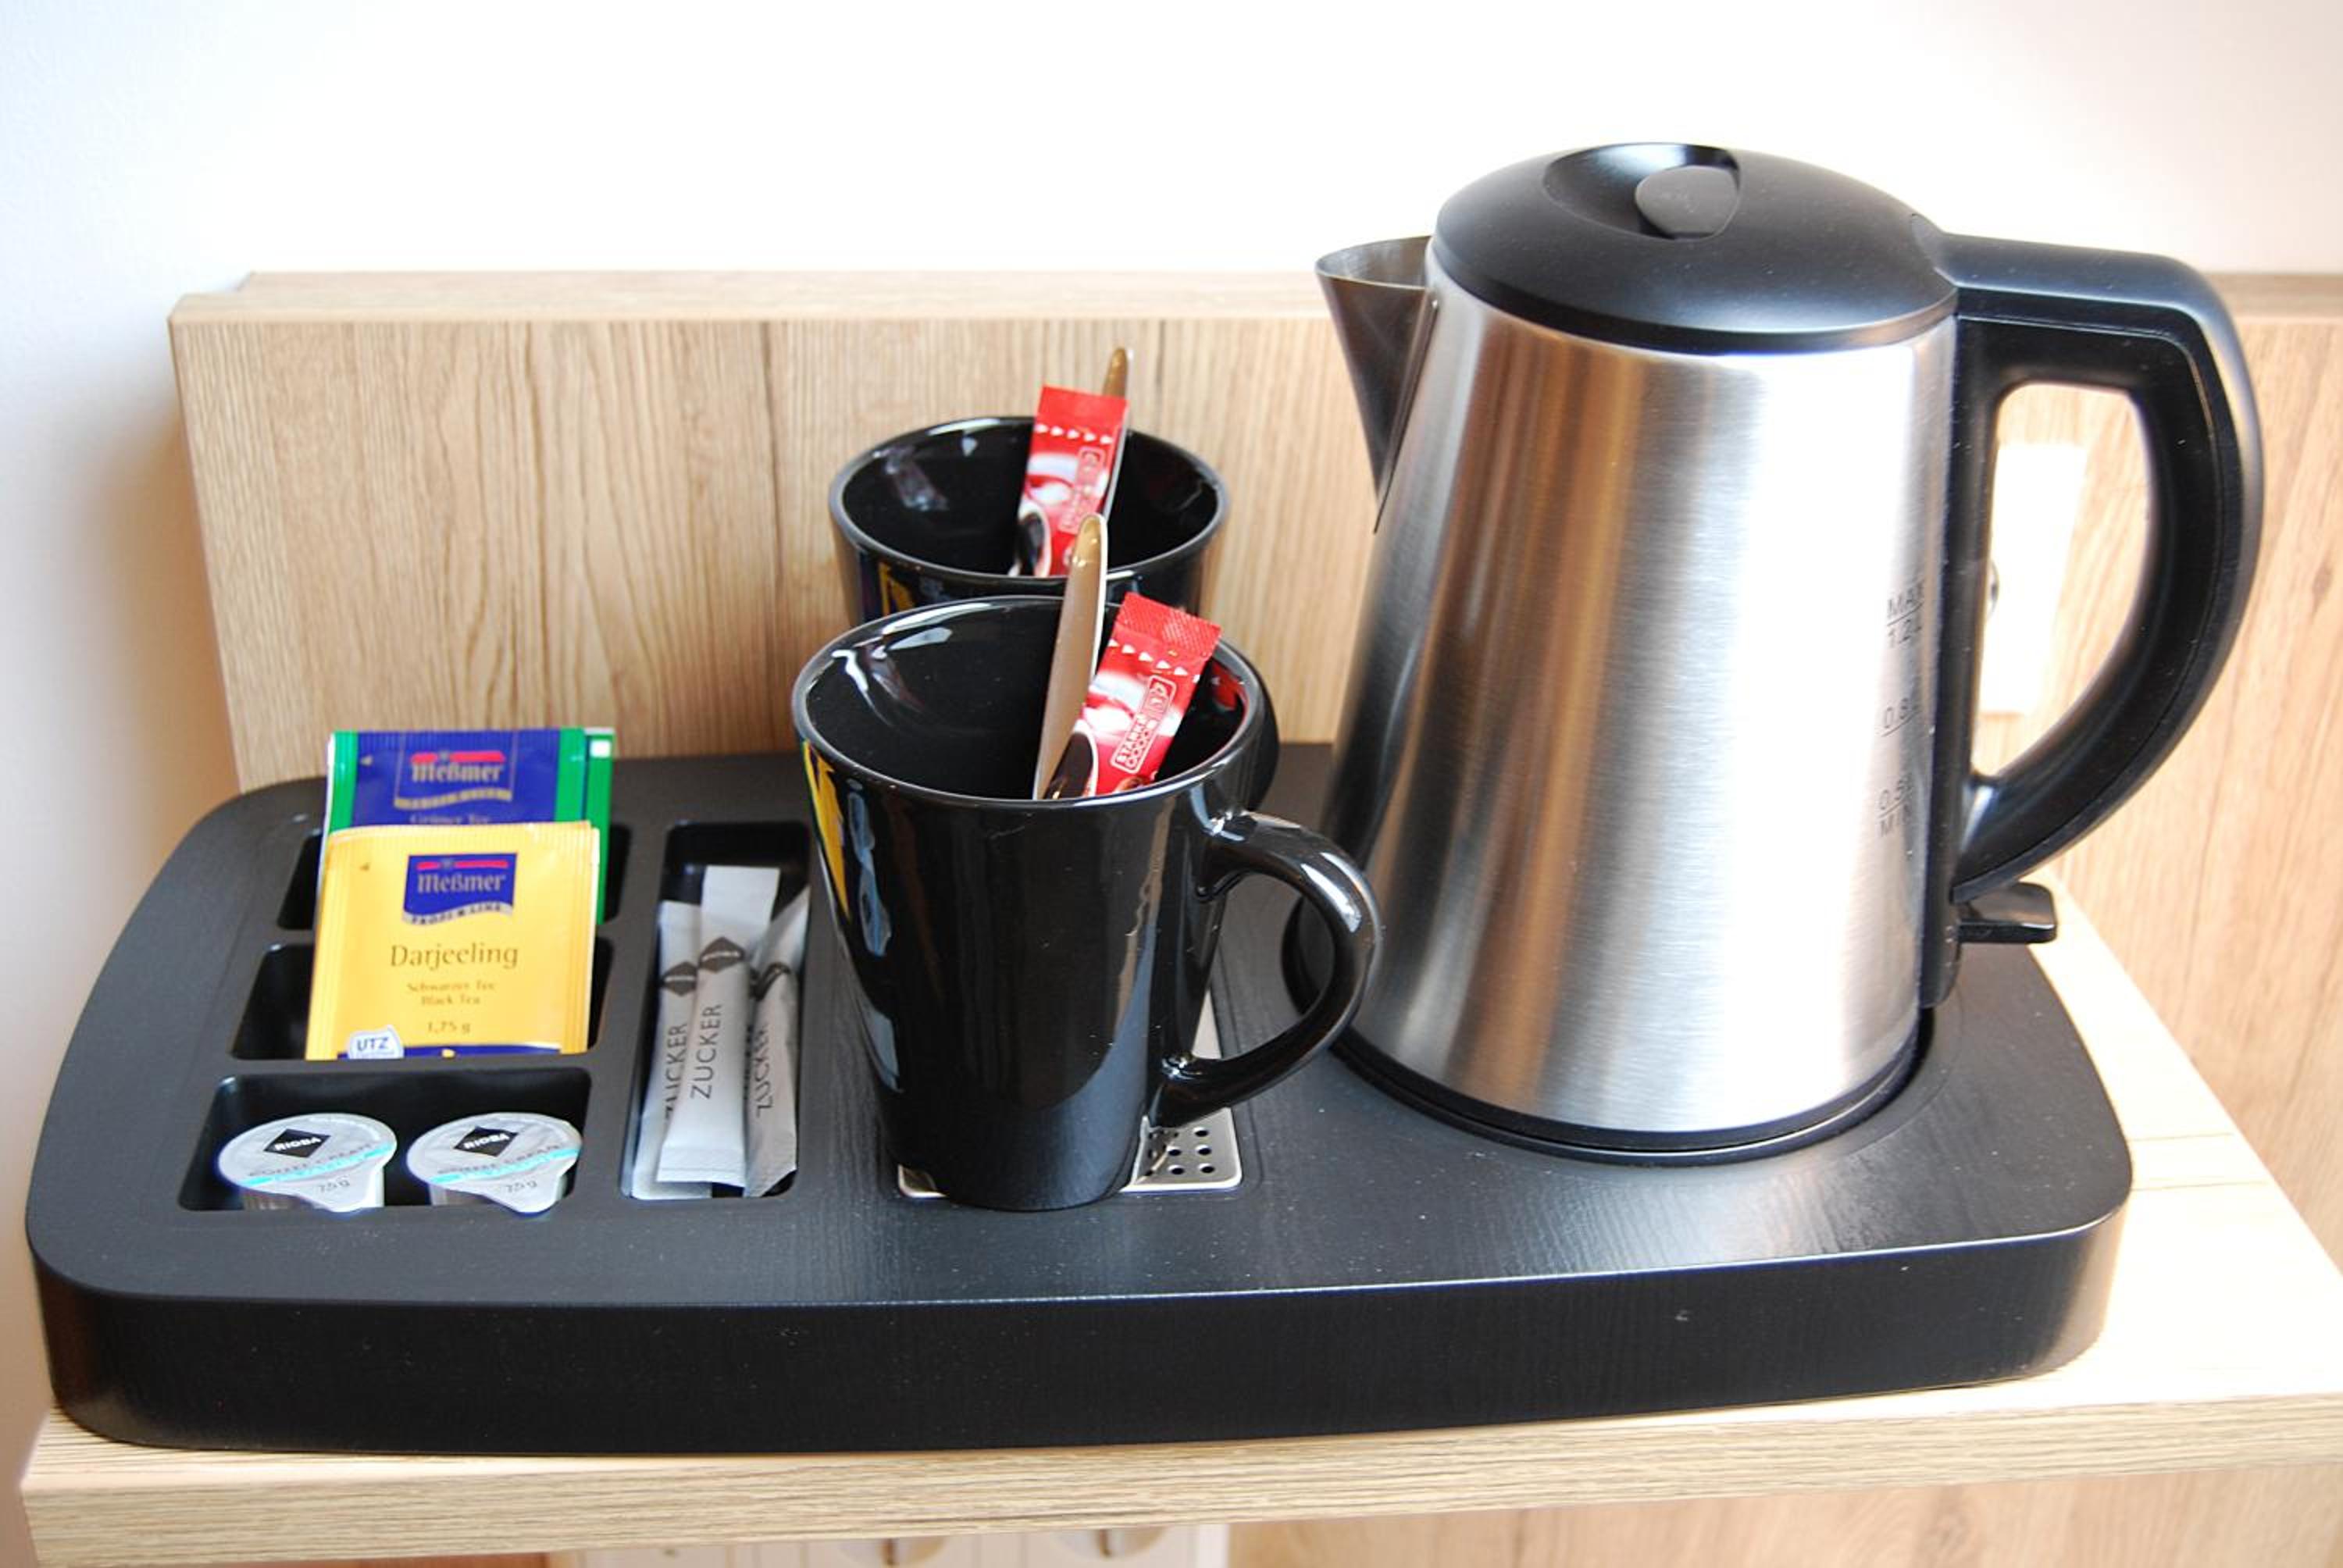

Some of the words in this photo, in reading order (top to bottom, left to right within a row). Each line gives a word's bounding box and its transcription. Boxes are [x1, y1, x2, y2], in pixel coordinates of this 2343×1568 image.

[412, 762, 504, 782] Meßmer
[417, 871, 506, 893] Meßmer
[390, 942, 519, 971] Darjeeling
[462, 1021, 472, 1035] g
[356, 1035, 390, 1052] UTZ
[690, 1003, 722, 1100] ZUCKER
[274, 1136, 322, 1152] RIOBA
[463, 1132, 510, 1149] RIOBA
